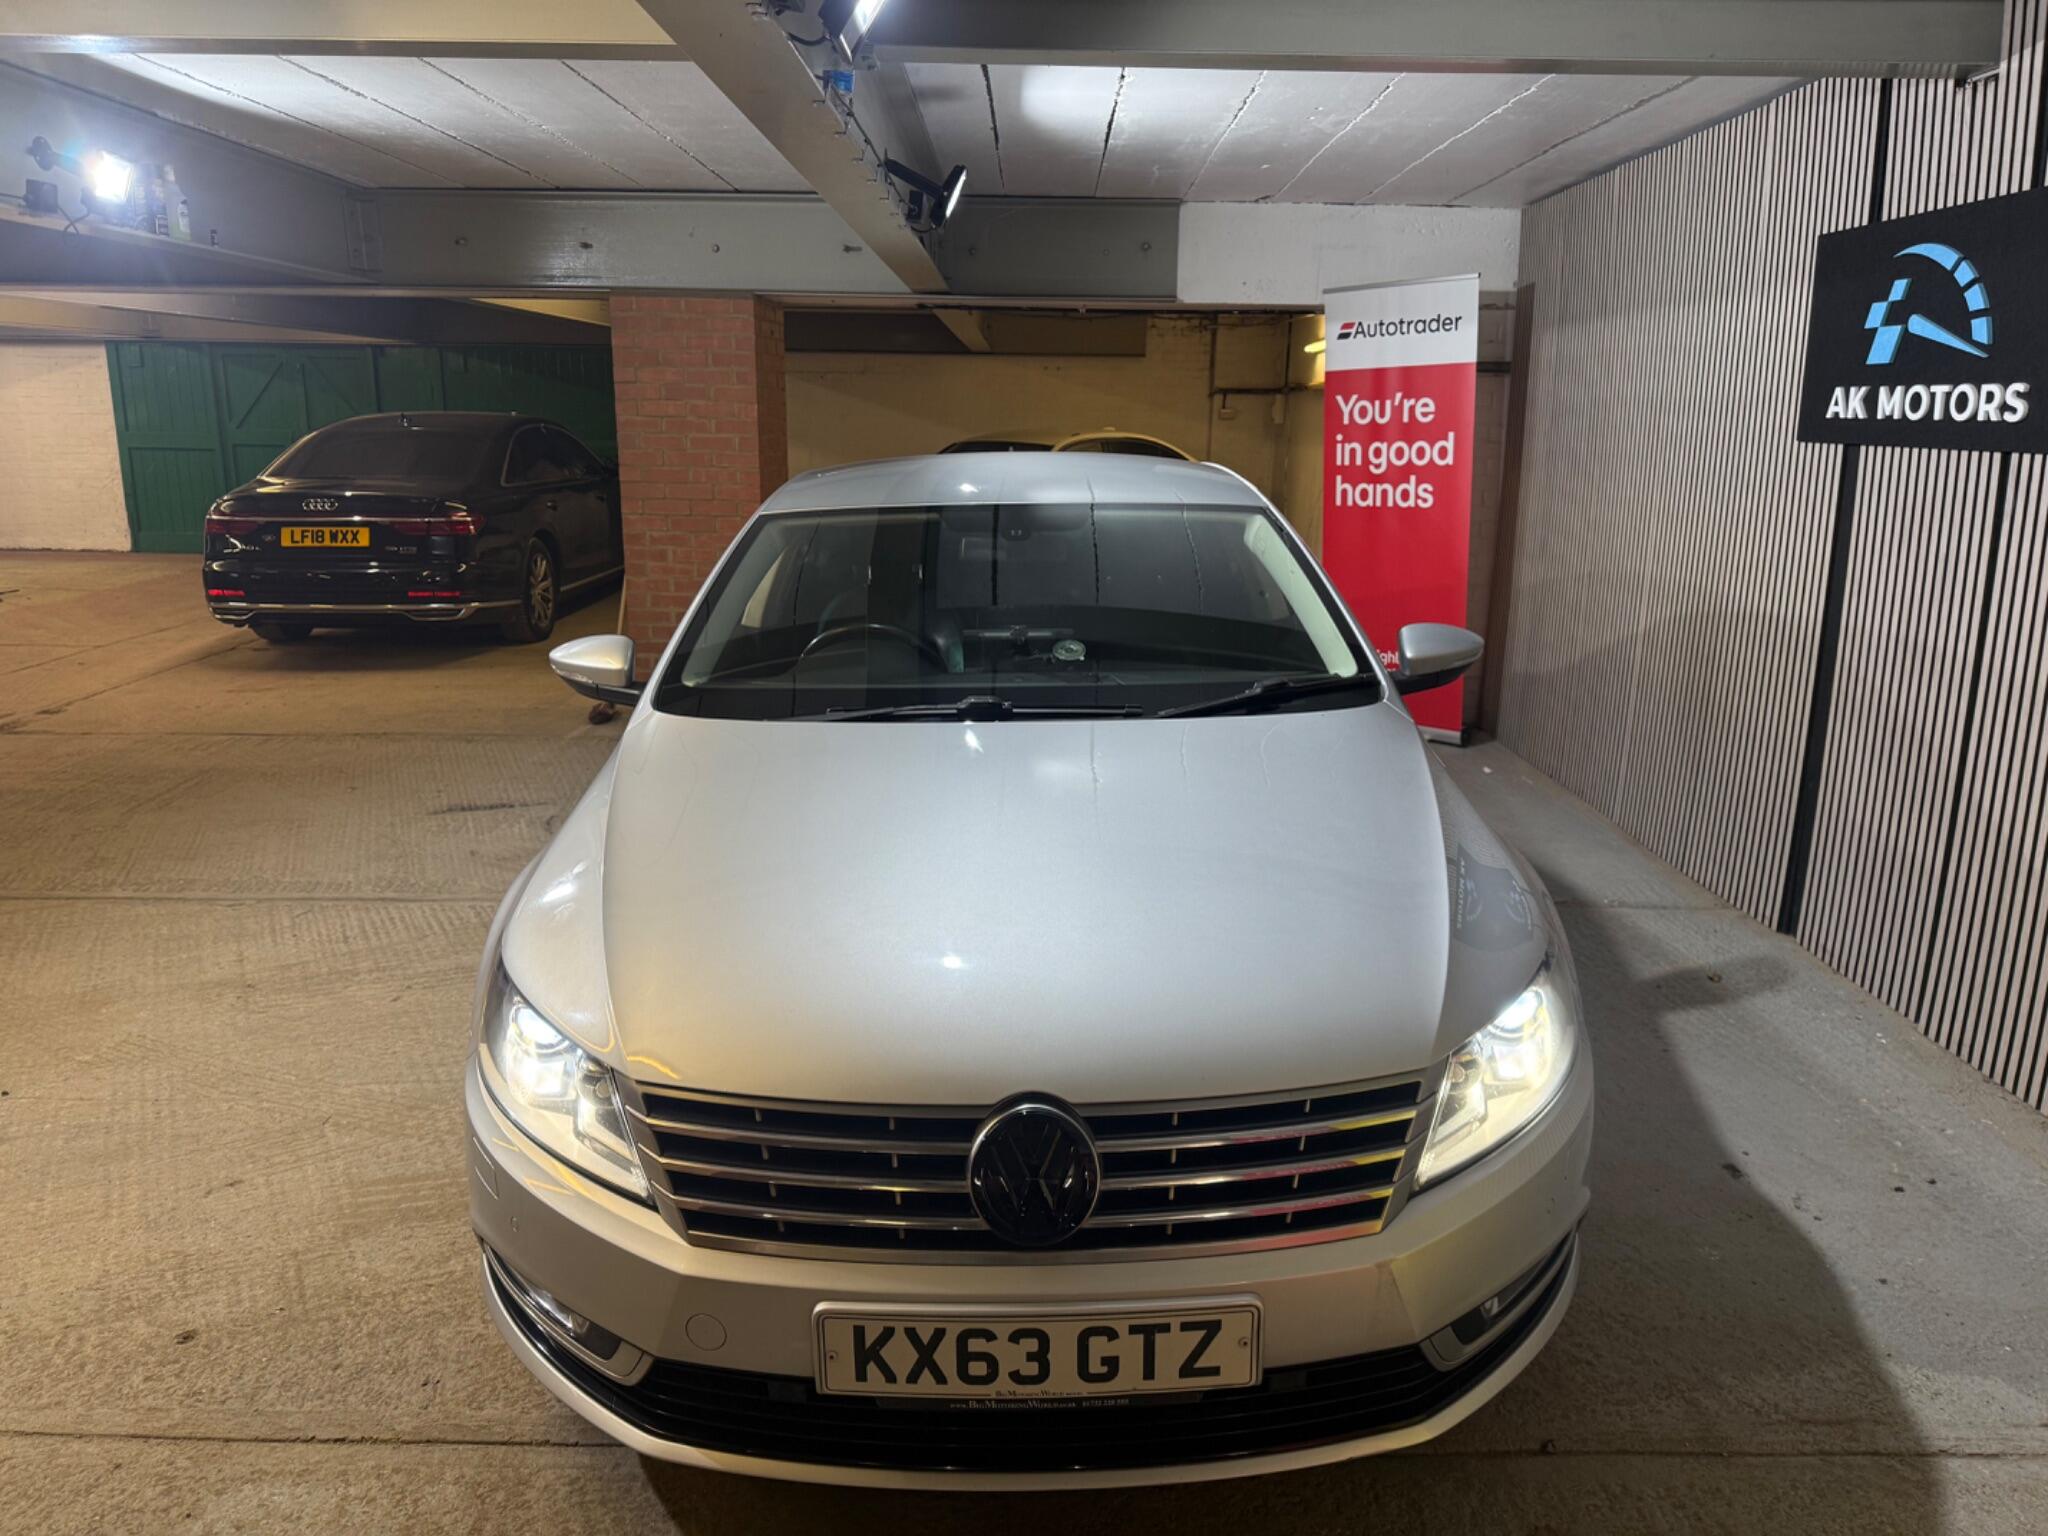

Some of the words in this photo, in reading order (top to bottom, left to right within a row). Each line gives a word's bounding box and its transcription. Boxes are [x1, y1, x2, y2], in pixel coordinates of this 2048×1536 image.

[1353, 314, 1463, 339] Autotrader
[1335, 392, 1436, 425] You're
[1825, 385, 1871, 419] AK
[1877, 382, 2030, 423] MOTORS
[1335, 433, 1362, 466] in
[1368, 431, 1455, 474] good
[1335, 475, 1434, 509] hands
[290, 529, 325, 544] LF18
[329, 529, 360, 543] WXX
[852, 1324, 1051, 1386] KX63
[1075, 1319, 1223, 1384] GTZ
